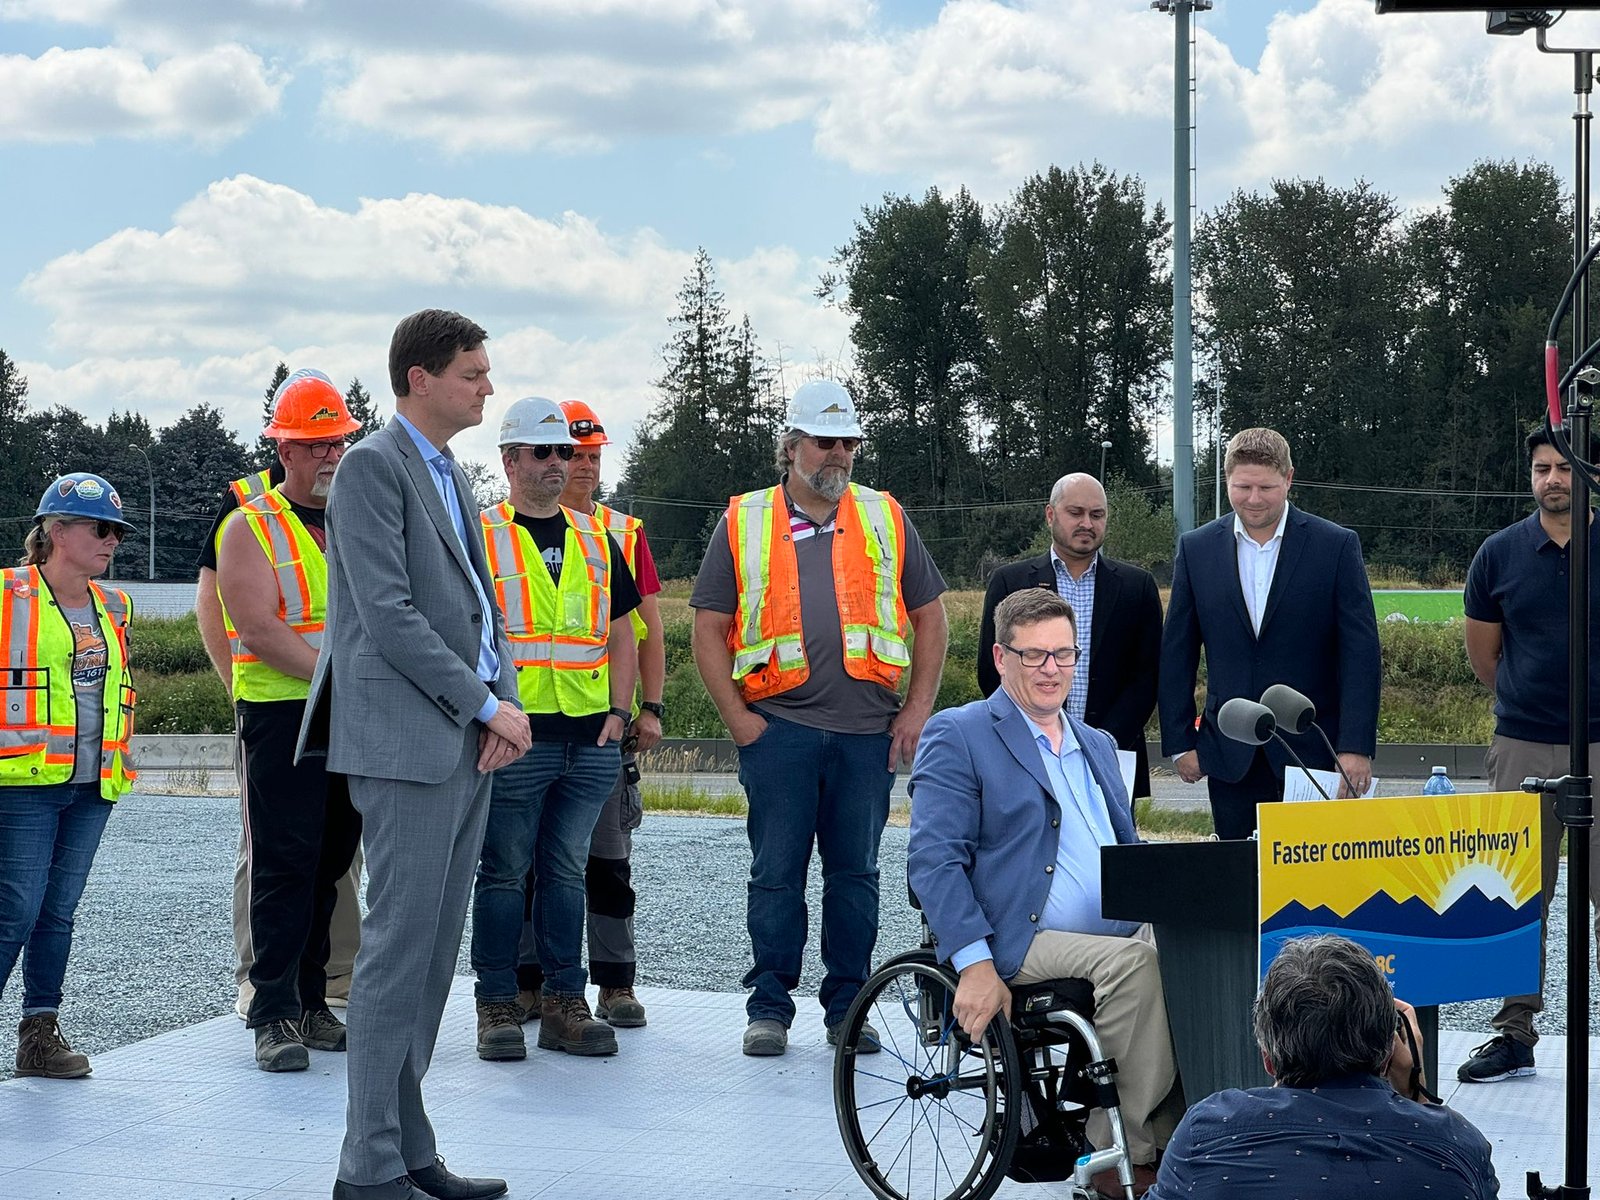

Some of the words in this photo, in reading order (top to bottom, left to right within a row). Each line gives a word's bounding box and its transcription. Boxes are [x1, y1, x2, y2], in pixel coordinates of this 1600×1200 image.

[87, 667, 106, 678] 1611
[1273, 841, 1327, 865] Faster
[1332, 836, 1420, 861] commutes
[1424, 836, 1445, 855] on
[1450, 828, 1518, 859] Highway
[1522, 826, 1530, 849] 1
